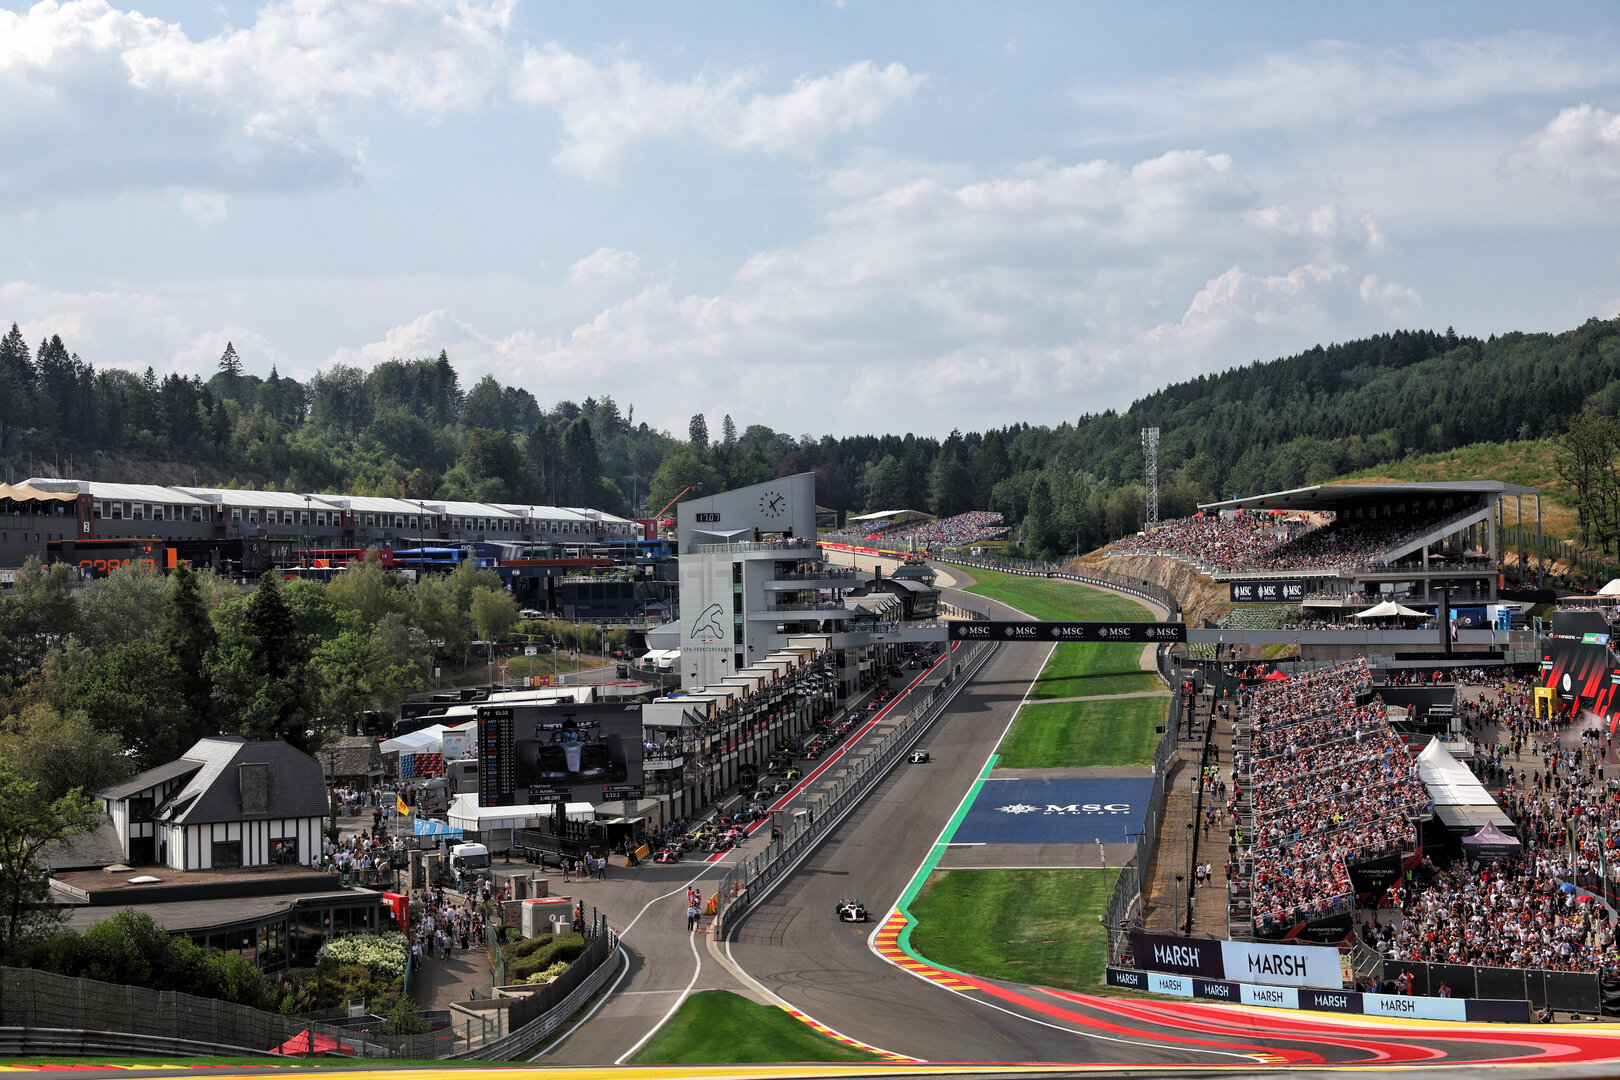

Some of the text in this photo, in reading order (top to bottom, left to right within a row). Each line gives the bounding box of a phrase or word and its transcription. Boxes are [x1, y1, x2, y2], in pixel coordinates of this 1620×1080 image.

[85, 523, 89, 531] 2
[1240, 586, 1251, 595] MSC
[1264, 586, 1276, 595] MSC
[1289, 586, 1302, 595] MSC
[1154, 944, 1200, 968] MARSH
[1248, 952, 1306, 976] MARSH
[1116, 972, 1138, 985] MARSH
[1159, 978, 1181, 991] MARSH
[1204, 984, 1229, 997] MARSH
[1253, 990, 1283, 1002] MARSH
[1314, 995, 1347, 1008] MARSH
[1380, 1000, 1415, 1012] MARSH
